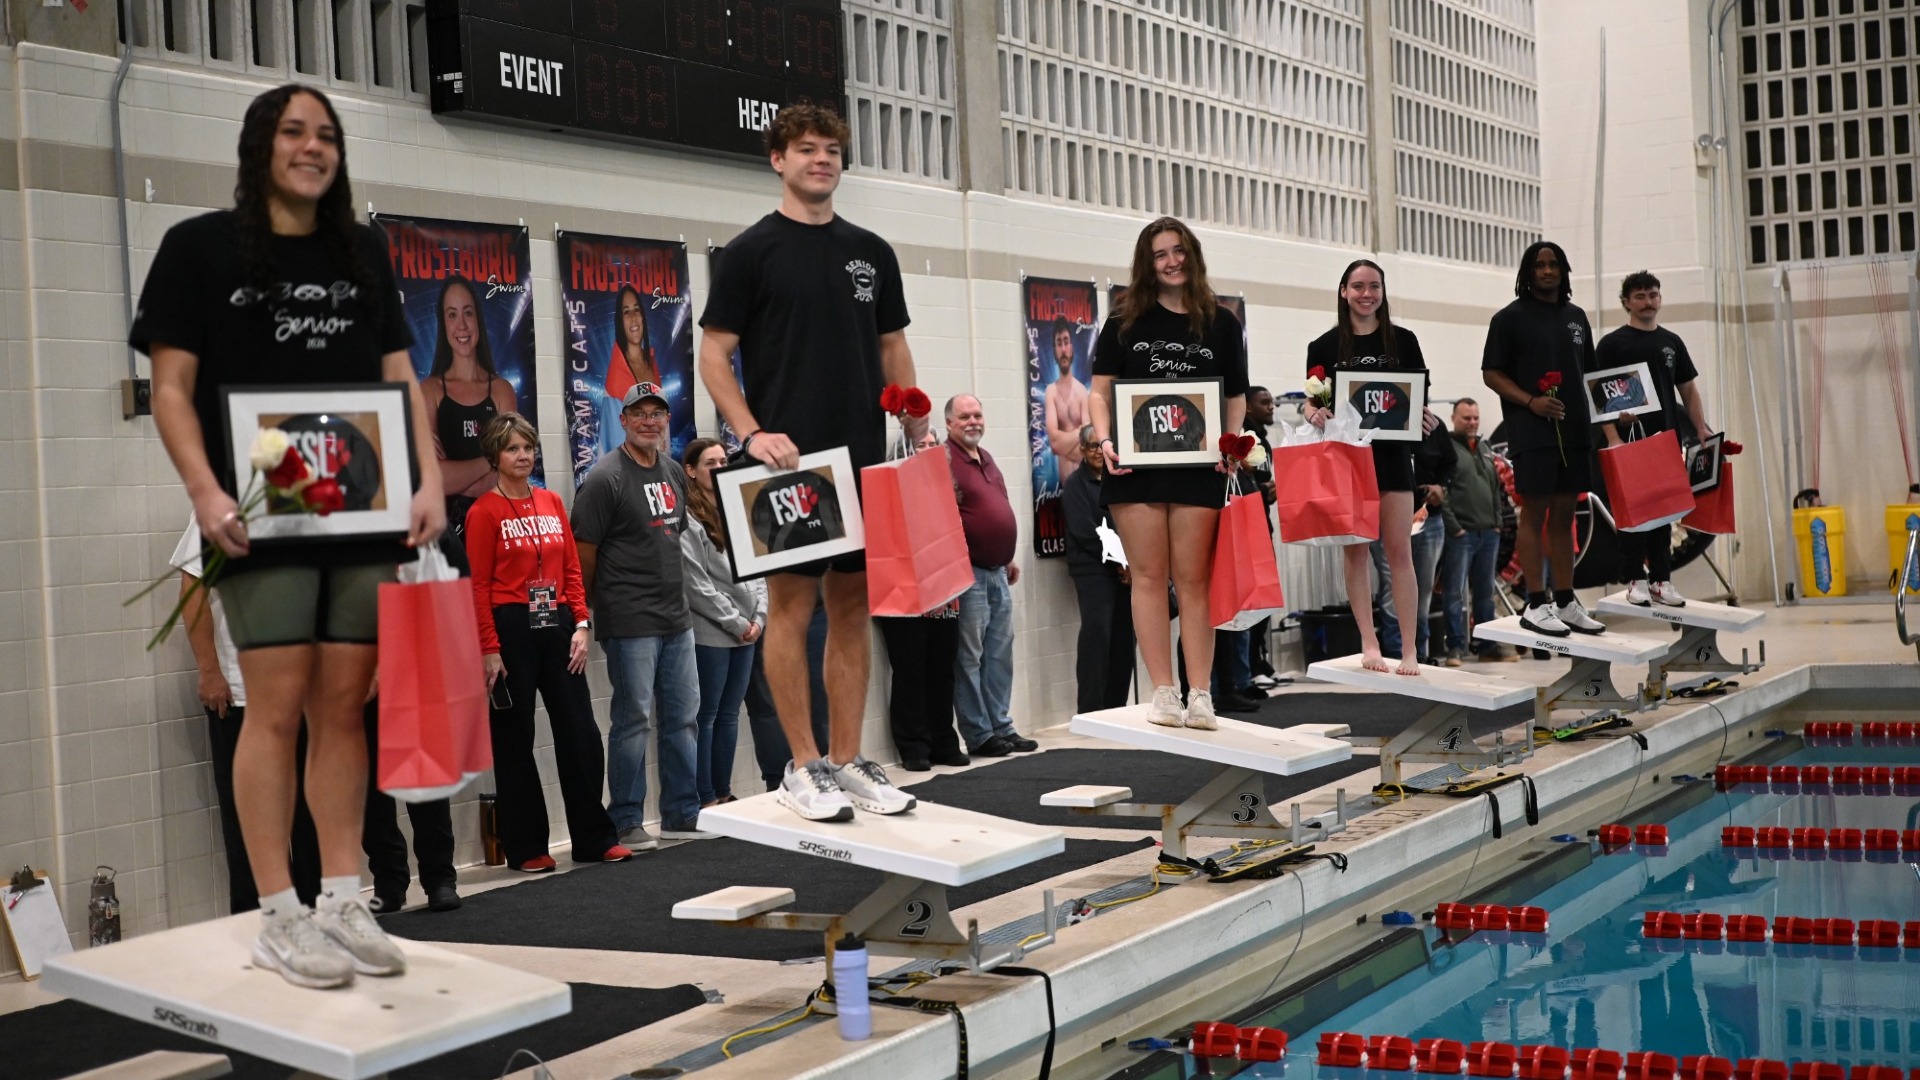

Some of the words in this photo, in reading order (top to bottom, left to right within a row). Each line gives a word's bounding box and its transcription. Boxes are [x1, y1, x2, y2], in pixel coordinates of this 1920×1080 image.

[500, 52, 563, 96] EVENT
[738, 96, 779, 131] HEAT
[570, 241, 678, 296] FROSTBURG
[845, 260, 876, 275] SENIOR
[486, 274, 526, 299] Swim
[651, 287, 685, 310] Swim
[274, 307, 353, 342] Senior
[1150, 354, 1196, 372] Senior
[1365, 390, 1390, 414] FSU
[1149, 404, 1179, 434] FSU
[769, 483, 811, 526] FSU
[1035, 480, 1064, 512] Andr
[505, 535, 564, 550] SWIMMI
[1042, 538, 1065, 553] CLAS
[1695, 646, 1710, 664] 6
[1583, 678, 1605, 698] 5
[1437, 725, 1463, 752] 4
[1232, 793, 1261, 824] 3
[899, 899, 934, 938] 2
